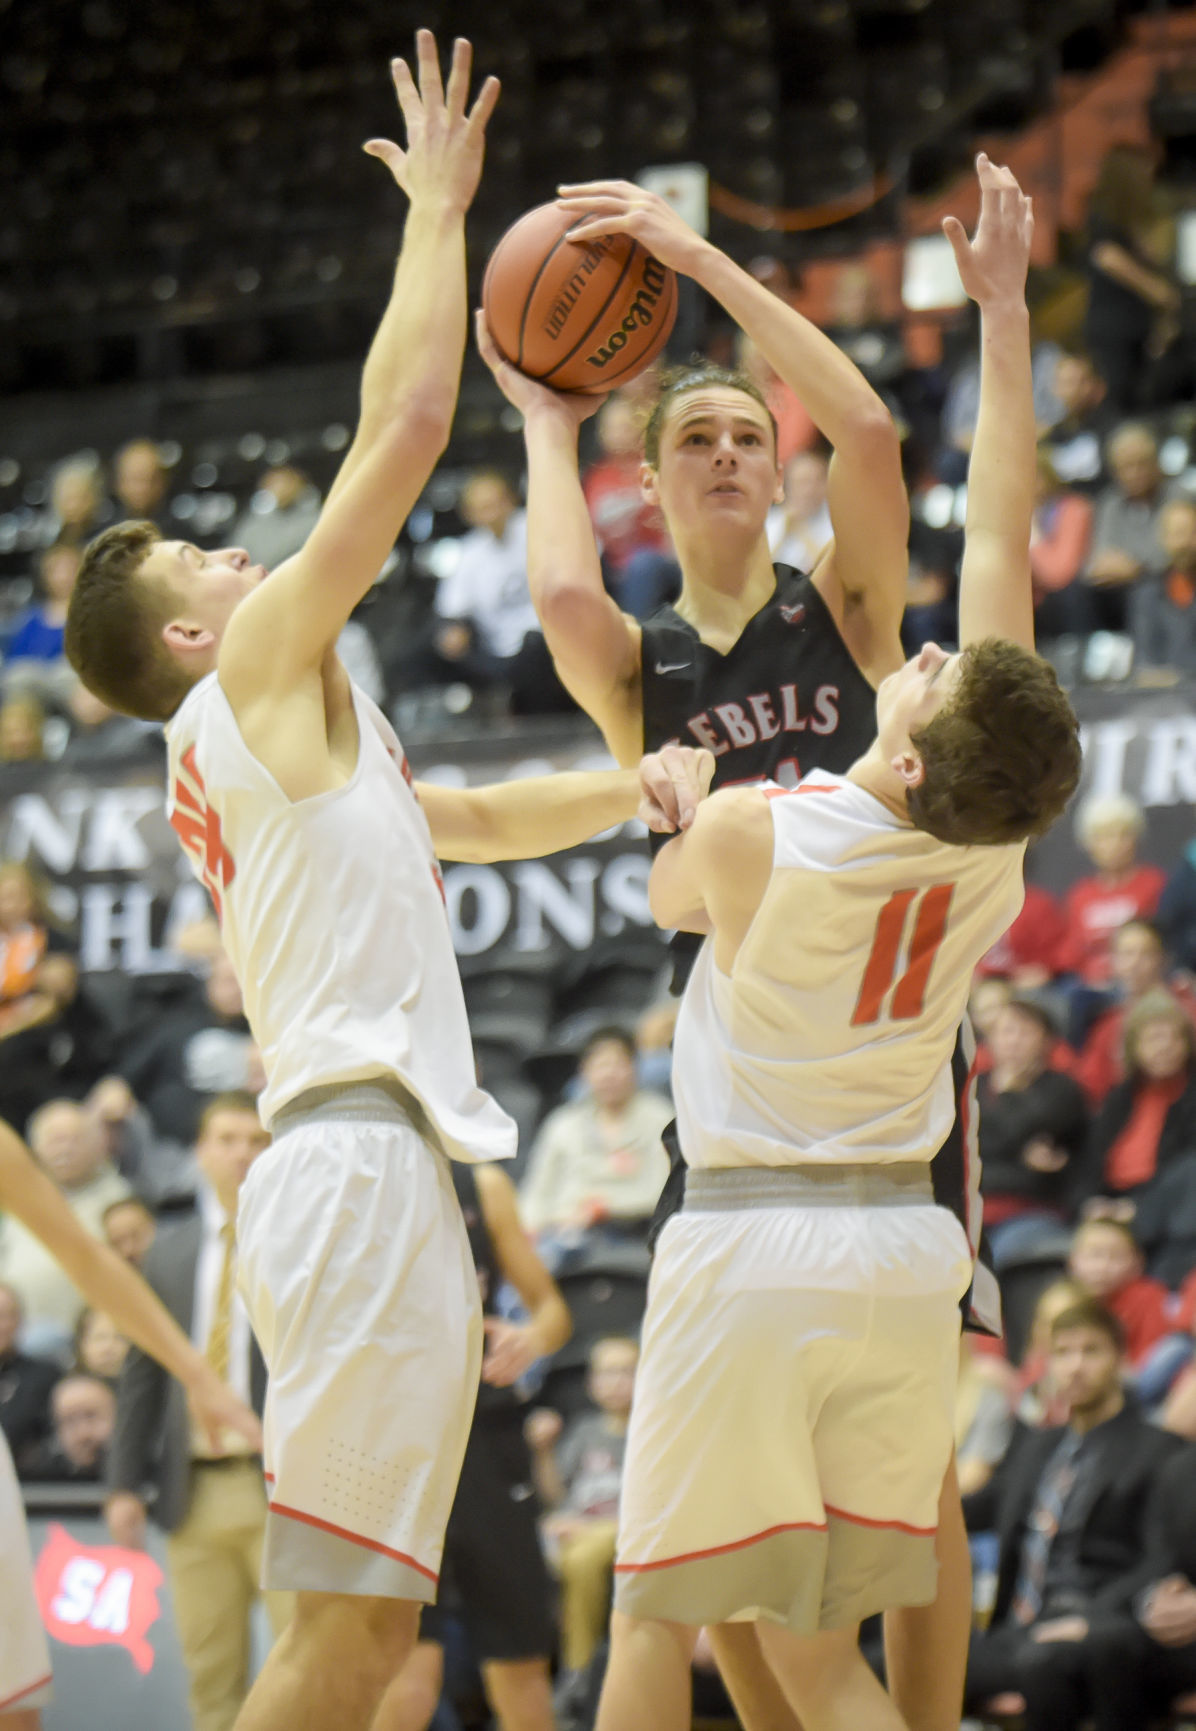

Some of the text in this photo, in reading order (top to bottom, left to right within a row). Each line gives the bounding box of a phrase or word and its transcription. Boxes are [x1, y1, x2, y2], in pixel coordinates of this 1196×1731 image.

[584, 254, 668, 369] Wilson
[661, 683, 841, 757] EBELS
[849, 880, 956, 1026] 11
